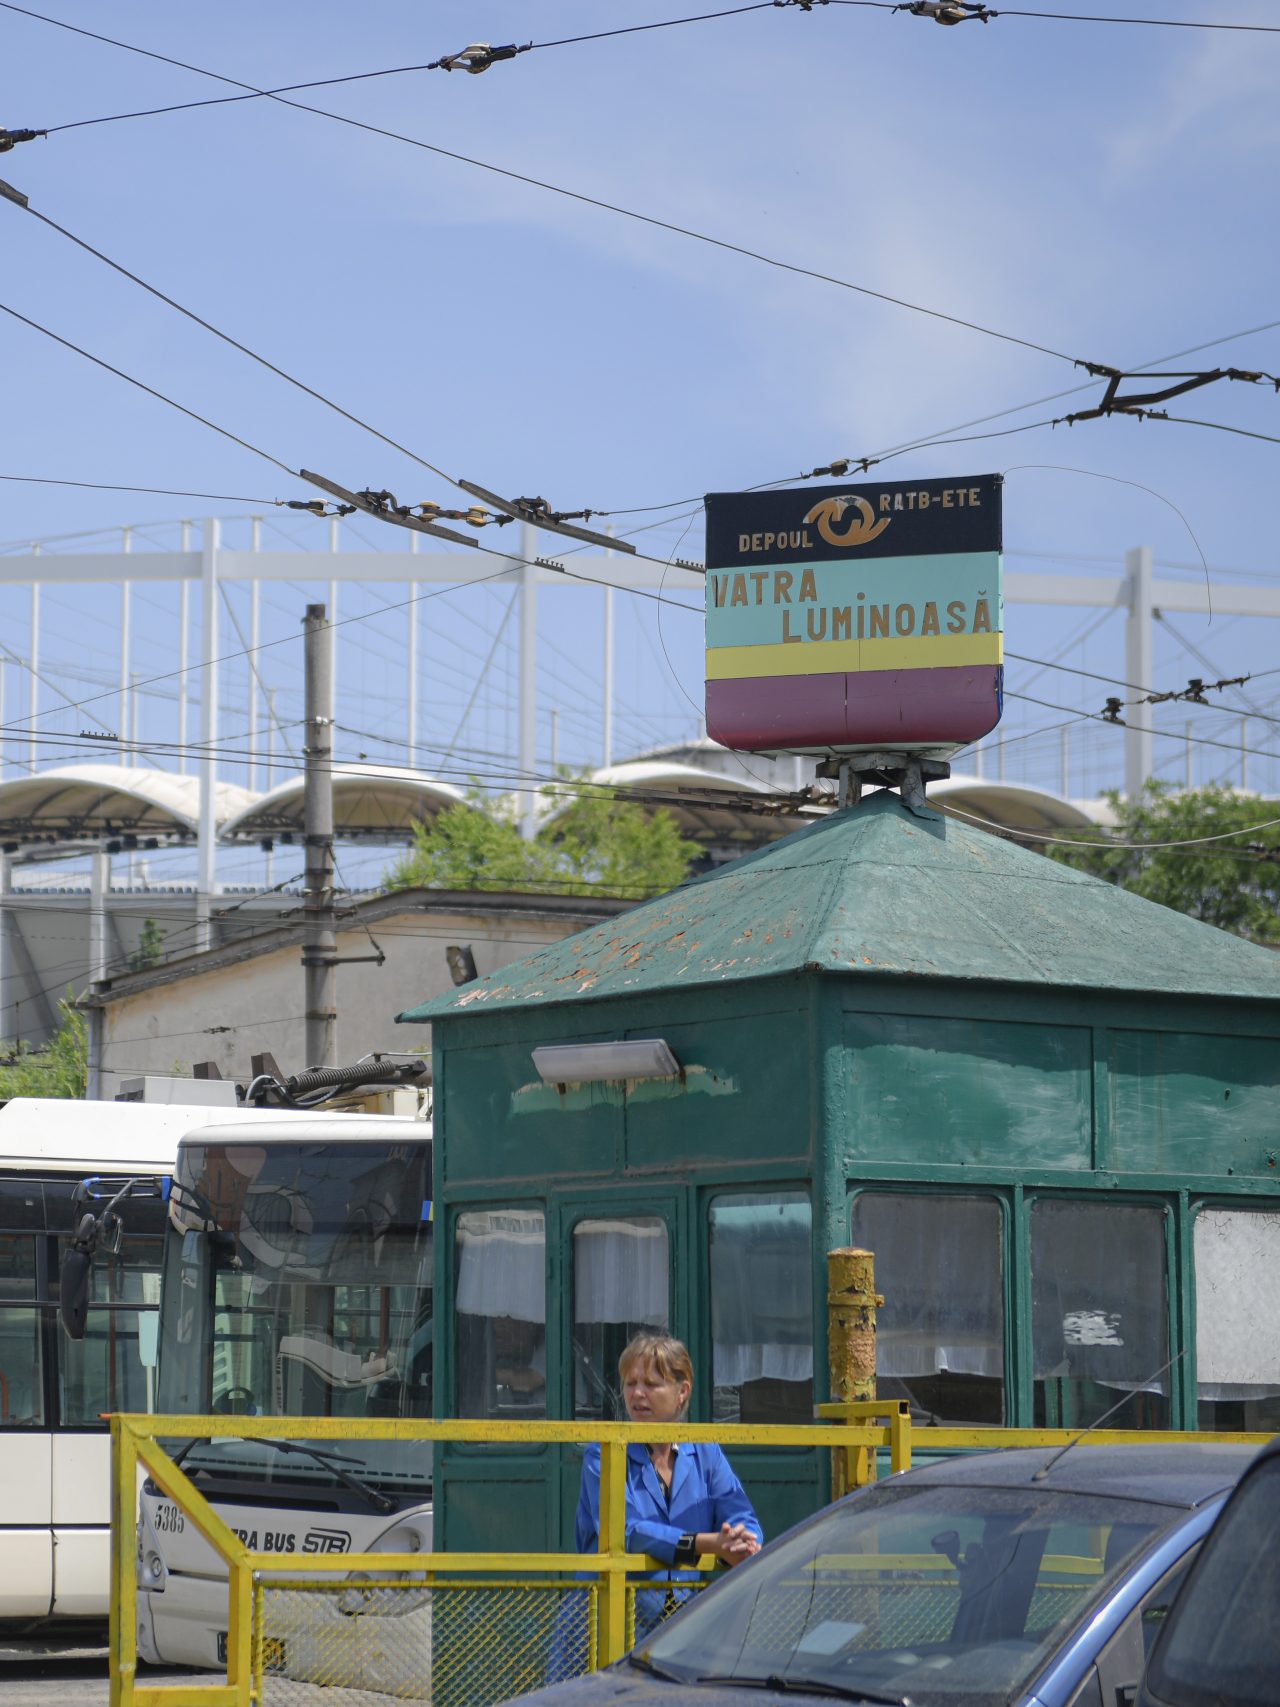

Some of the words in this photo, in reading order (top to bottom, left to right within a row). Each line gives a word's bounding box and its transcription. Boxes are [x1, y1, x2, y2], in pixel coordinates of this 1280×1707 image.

[879, 488, 981, 512] RATB-ETE
[739, 530, 814, 552] DEPOUL
[711, 568, 818, 608] VATRA
[154, 1504, 185, 1534] 5385
[263, 1532, 296, 1553] BUS
[302, 1530, 349, 1553] STB
